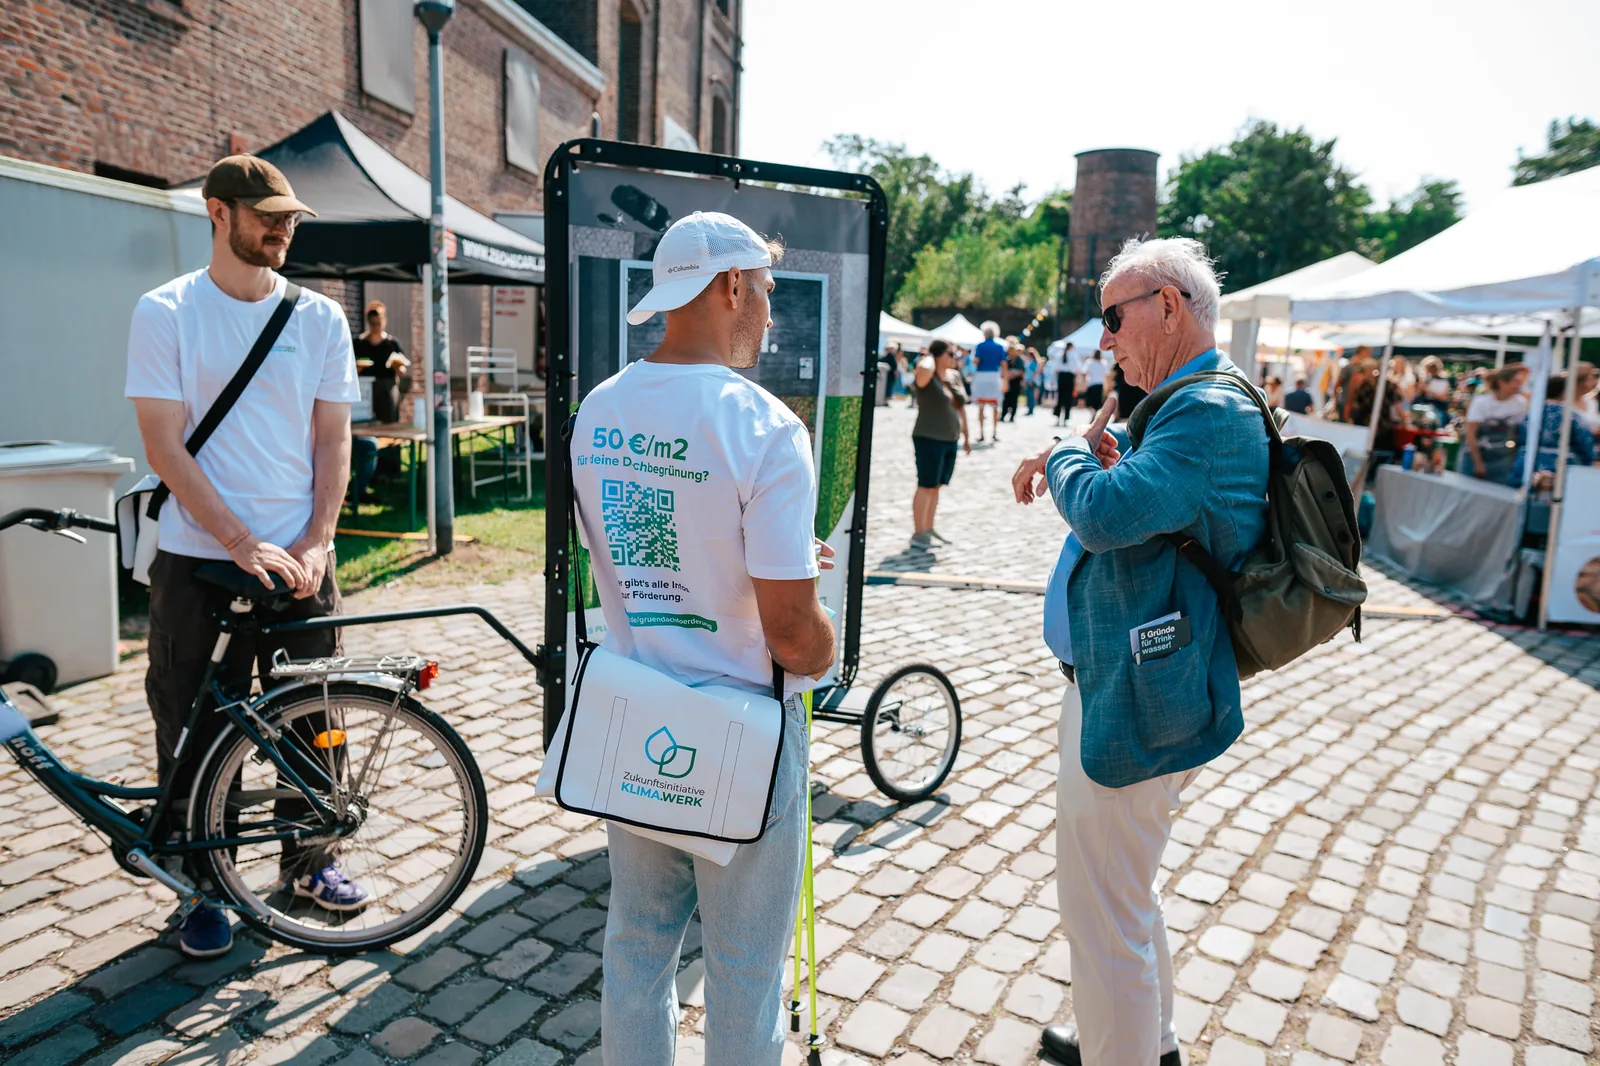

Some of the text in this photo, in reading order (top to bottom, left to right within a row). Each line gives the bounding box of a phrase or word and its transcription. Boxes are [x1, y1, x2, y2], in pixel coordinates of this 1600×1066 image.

[673, 264, 700, 272] Columbia
[592, 427, 688, 461] 50 €/m2
[577, 455, 588, 466] für
[623, 456, 709, 483] Dchbegrünung?
[625, 578, 649, 588] gibt's
[651, 580, 669, 589] alle
[632, 590, 683, 603] Förderung.
[1141, 626, 1175, 640] 5 Gründe
[1141, 634, 1175, 647] für Trink-
[1141, 642, 1171, 654] wasser!
[623, 771, 705, 796] Zukunftsinitiative
[620, 781, 703, 808] KLIMA.WERK
